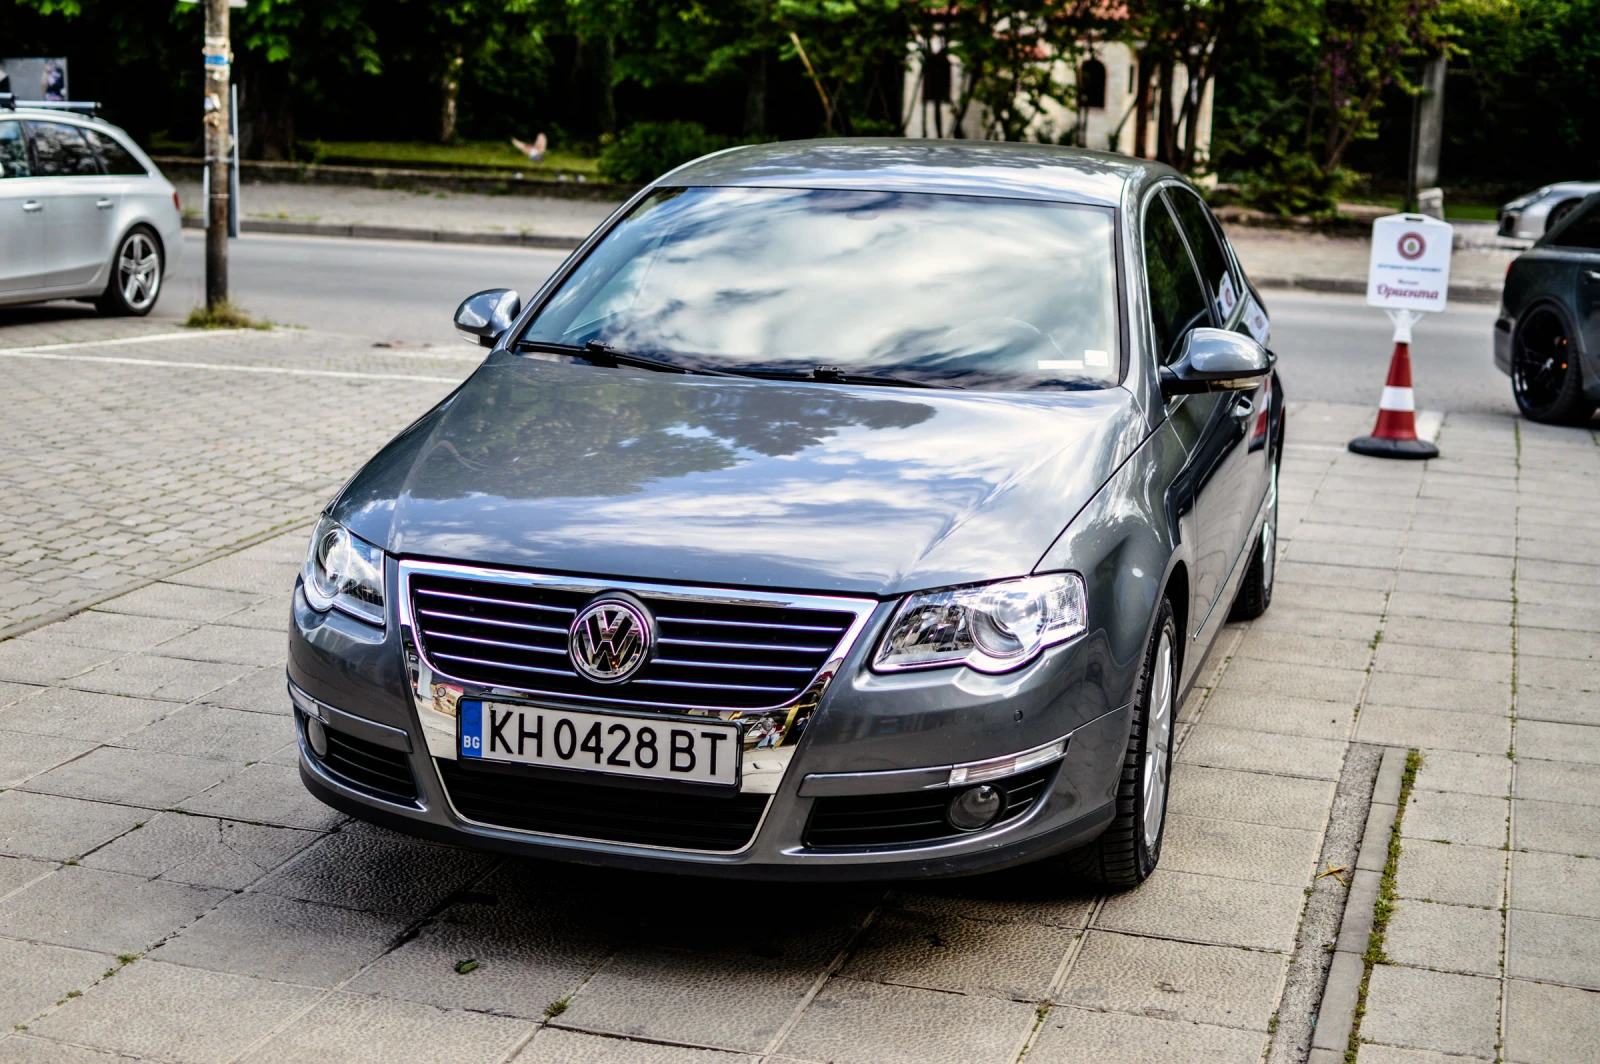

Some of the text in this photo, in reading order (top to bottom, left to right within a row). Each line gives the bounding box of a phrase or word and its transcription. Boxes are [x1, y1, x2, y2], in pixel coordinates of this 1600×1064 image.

[463, 735, 480, 749] BG
[489, 709, 728, 776] KH 0428 BT
